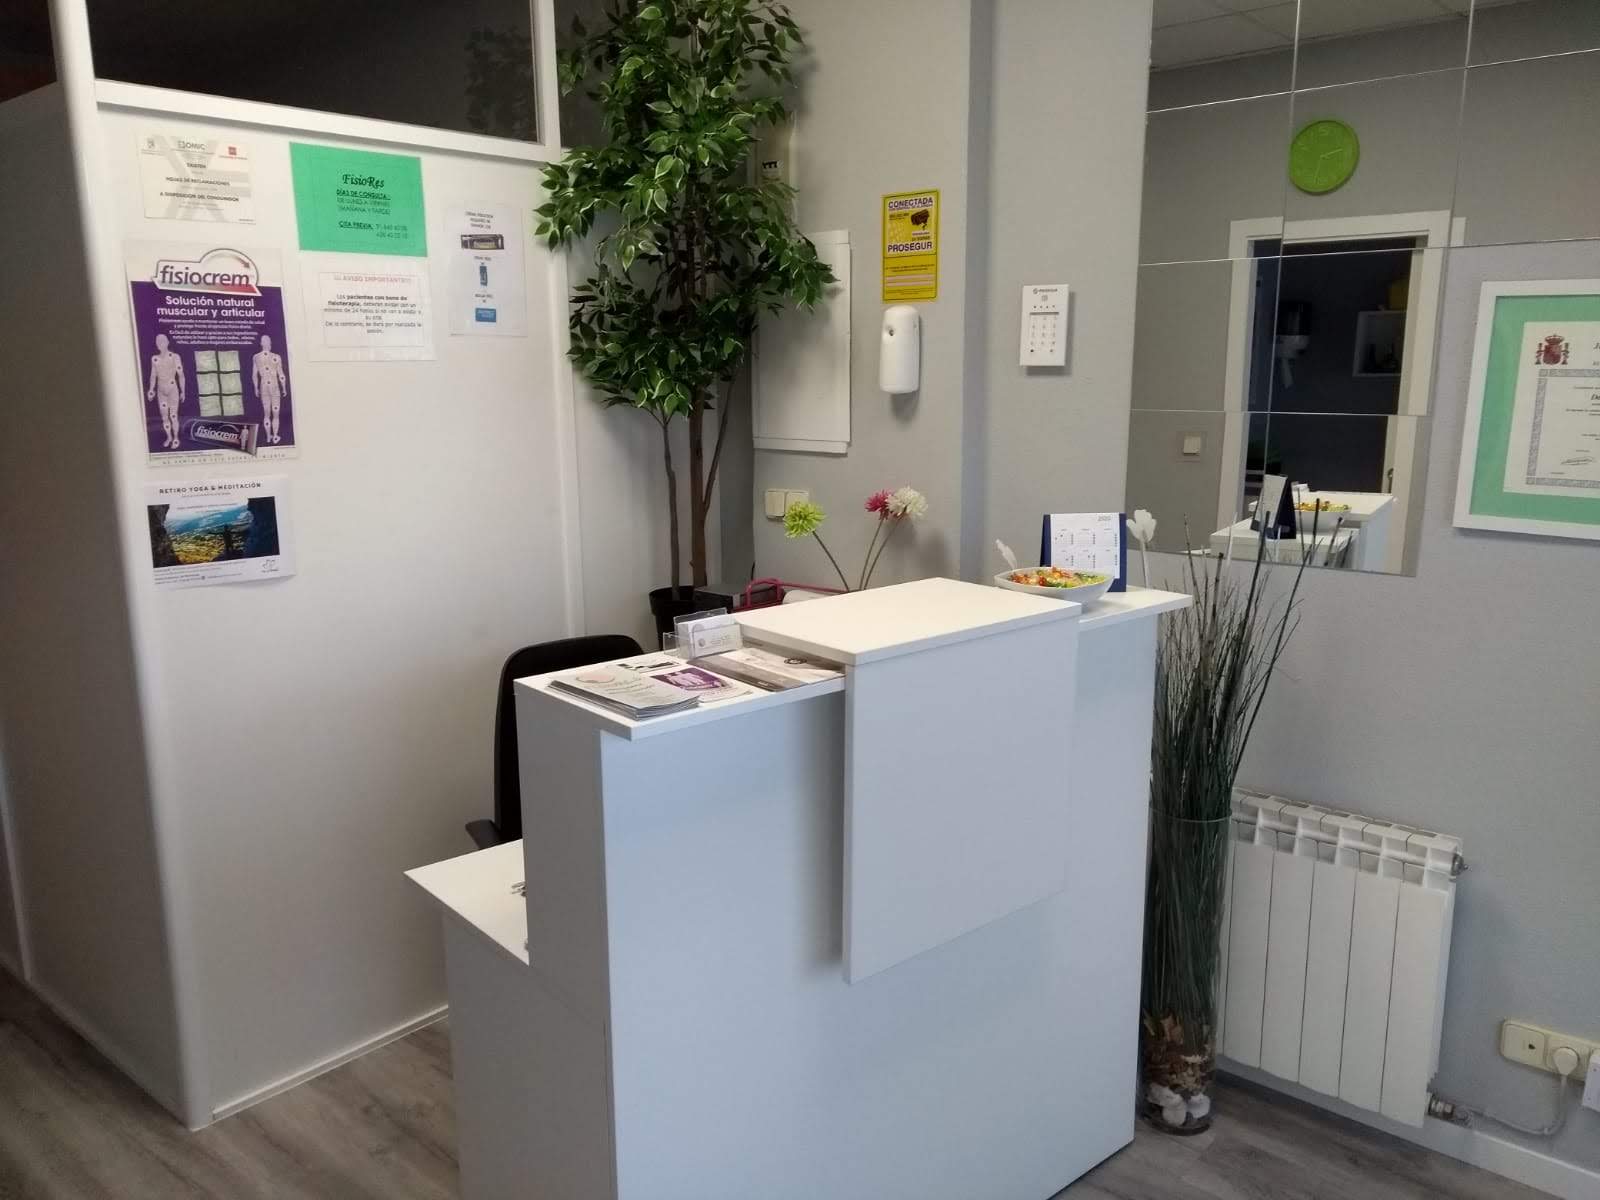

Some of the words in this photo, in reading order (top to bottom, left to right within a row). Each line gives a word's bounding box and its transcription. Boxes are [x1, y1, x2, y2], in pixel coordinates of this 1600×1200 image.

[342, 173, 386, 189] FisioRes
[888, 197, 934, 209] CONECTADA
[887, 241, 933, 254] PROSEGUR
[160, 264, 251, 288] fisiocrem
[165, 295, 214, 307] Solución
[216, 298, 255, 307] natural
[156, 307, 209, 317] muscular
[210, 309, 218, 319] y
[220, 308, 265, 318] articular
[194, 425, 239, 441] fisiocrem
[160, 487, 187, 495] RETIRO
[218, 482, 262, 491] MEDITACIÓN
